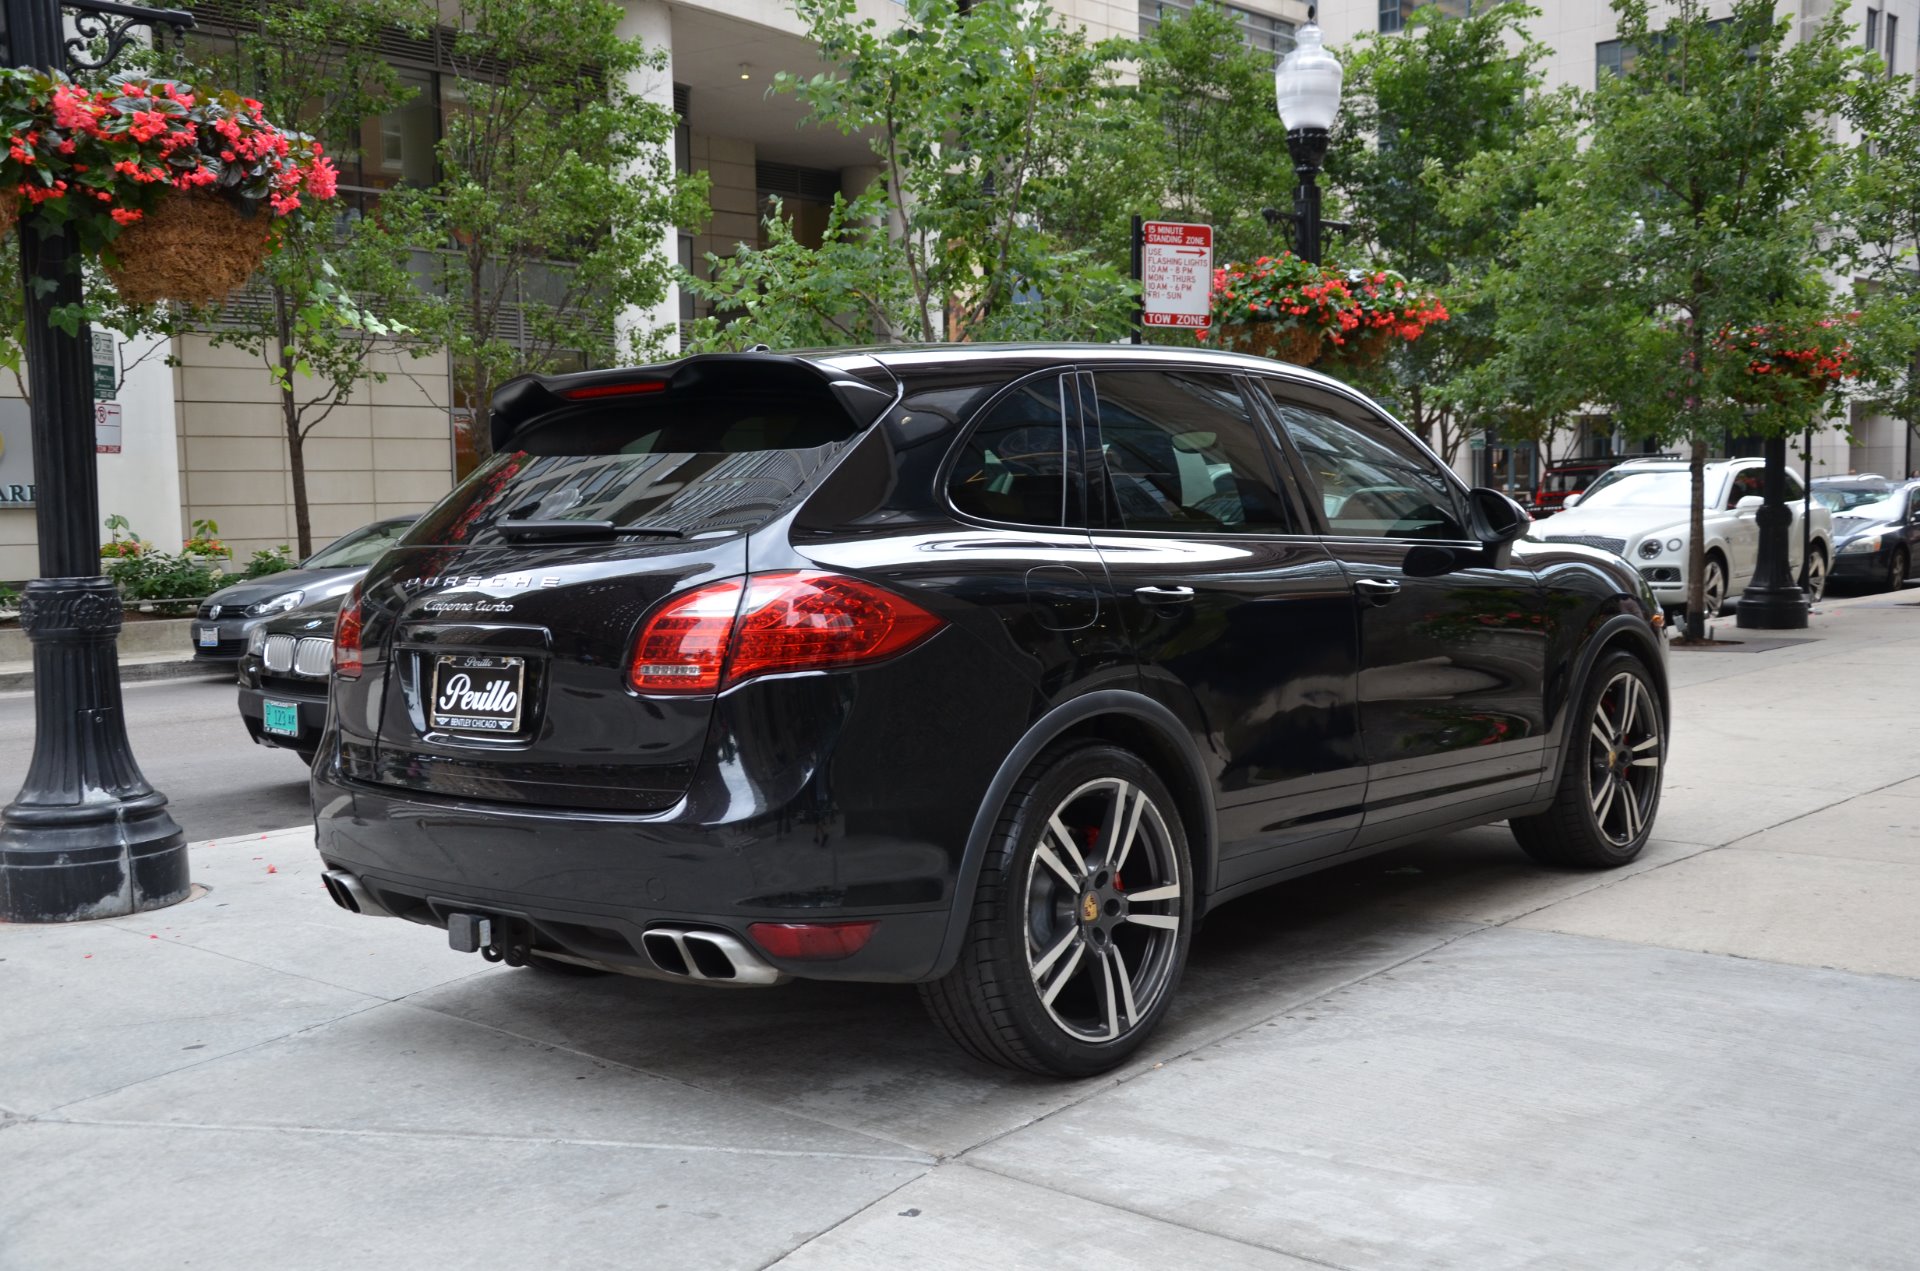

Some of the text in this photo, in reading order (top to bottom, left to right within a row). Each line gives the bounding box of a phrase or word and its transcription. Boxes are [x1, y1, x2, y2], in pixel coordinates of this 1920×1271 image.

[1148, 225, 1184, 235] 15 MINUTE
[1148, 234, 1205, 245] STANDING ZONE
[1148, 248, 1162, 256] USE
[1147, 257, 1208, 267] FLASHING LIGHTS
[1148, 273, 1164, 281] MON
[1172, 275, 1196, 283] THURS
[1147, 290, 1160, 299] FRI
[1166, 291, 1182, 299] SUN
[1148, 314, 1205, 326] TOW ZONE
[405, 575, 561, 588] PORSCHE
[423, 599, 474, 617] Cayenne
[464, 656, 493, 667] Perillo
[439, 673, 518, 713] Perillo
[450, 717, 497, 729] BENTLEY CHICAGO
